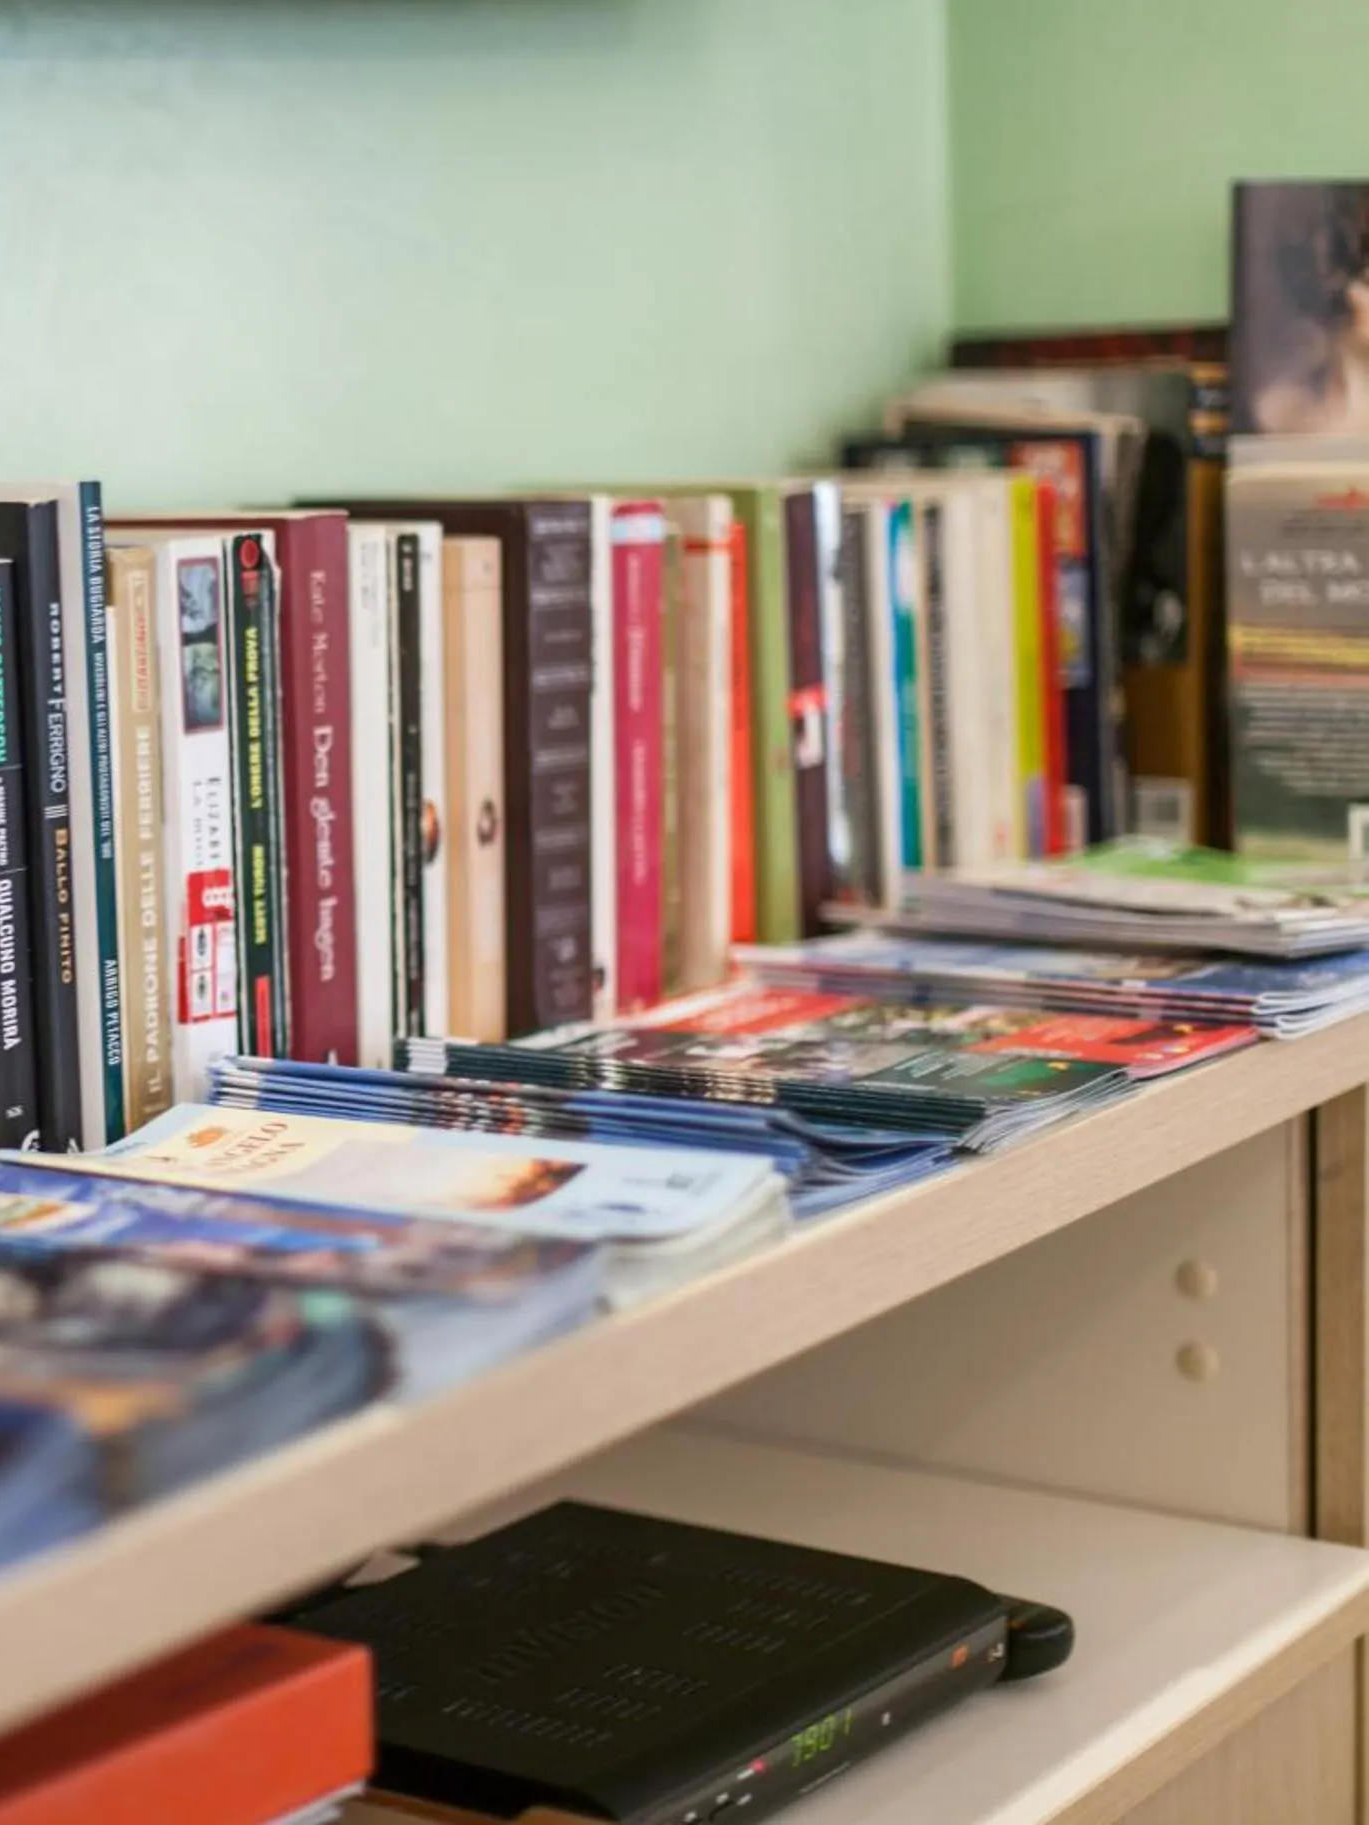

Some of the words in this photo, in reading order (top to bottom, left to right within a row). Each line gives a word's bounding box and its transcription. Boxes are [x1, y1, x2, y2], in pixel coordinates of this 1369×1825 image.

[87, 526, 103, 573] STORIA
[49, 602, 63, 695] ROBERT
[245, 627, 259, 681] PROVA
[46, 697, 67, 793] FERRIGNO
[247, 685, 260, 737] DELLA
[314, 725, 332, 788] Den
[54, 828, 70, 905] BALLO
[141, 851, 156, 928] DELLE
[60, 913, 73, 984] FINITO
[315, 898, 337, 981] hagen
[1, 980, 22, 1051] MORIRÀ
[105, 959, 119, 1008] ARRIGO
[145, 938, 162, 1062] PADRONE
[107, 1011, 120, 1066] PETACCO
